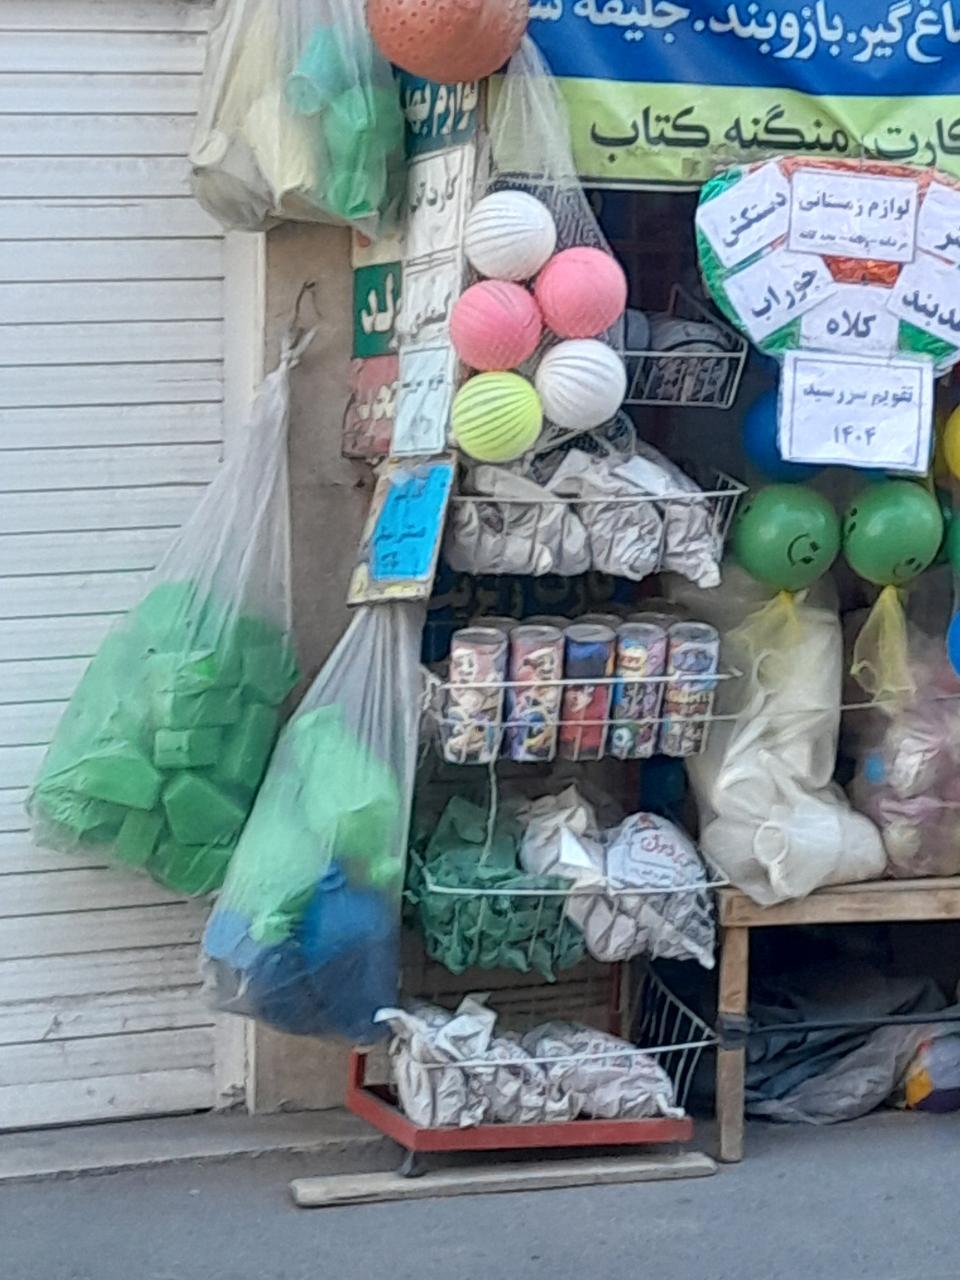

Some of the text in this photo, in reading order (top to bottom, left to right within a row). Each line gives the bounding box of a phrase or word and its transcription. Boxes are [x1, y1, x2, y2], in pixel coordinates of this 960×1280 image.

[590, 105, 711, 162] کتاب
[724, 104, 849, 153] منگنه
[751, 267, 820, 322] جوراب
[826, 311, 877, 339] کلاه
[833, 425, 877, 447] ۱۴۰۴
